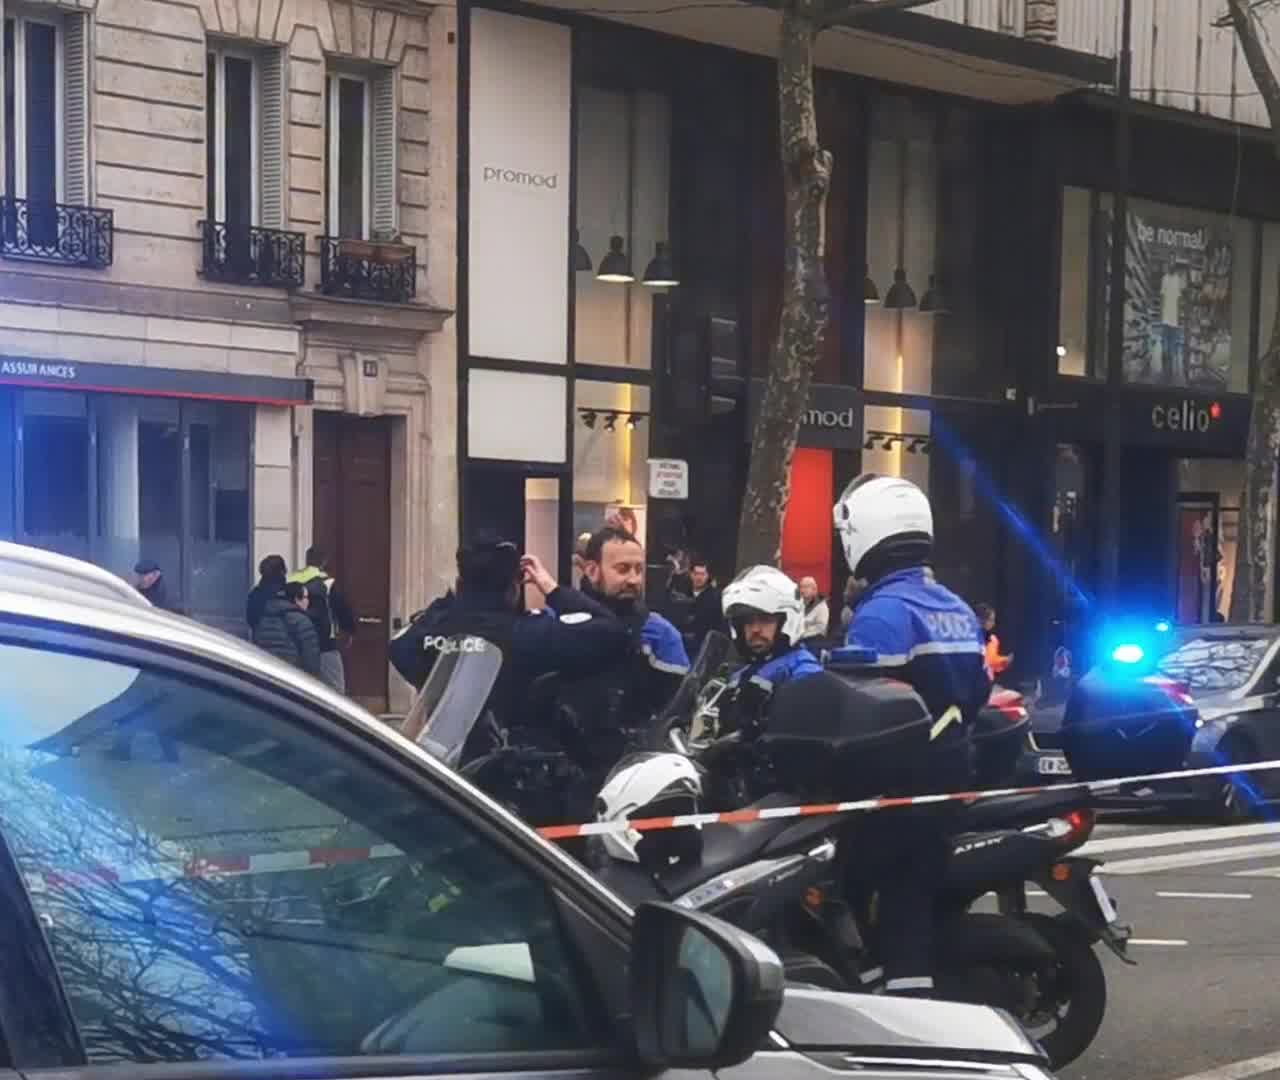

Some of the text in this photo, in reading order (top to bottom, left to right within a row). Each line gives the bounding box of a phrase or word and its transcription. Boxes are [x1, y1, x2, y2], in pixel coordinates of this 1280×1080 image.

[483, 167, 558, 189] promod
[1, 361, 77, 379] ASSURANCES
[1151, 400, 1210, 432] celio
[927, 612, 977, 640] POLICE
[423, 635, 486, 653] POLICE
